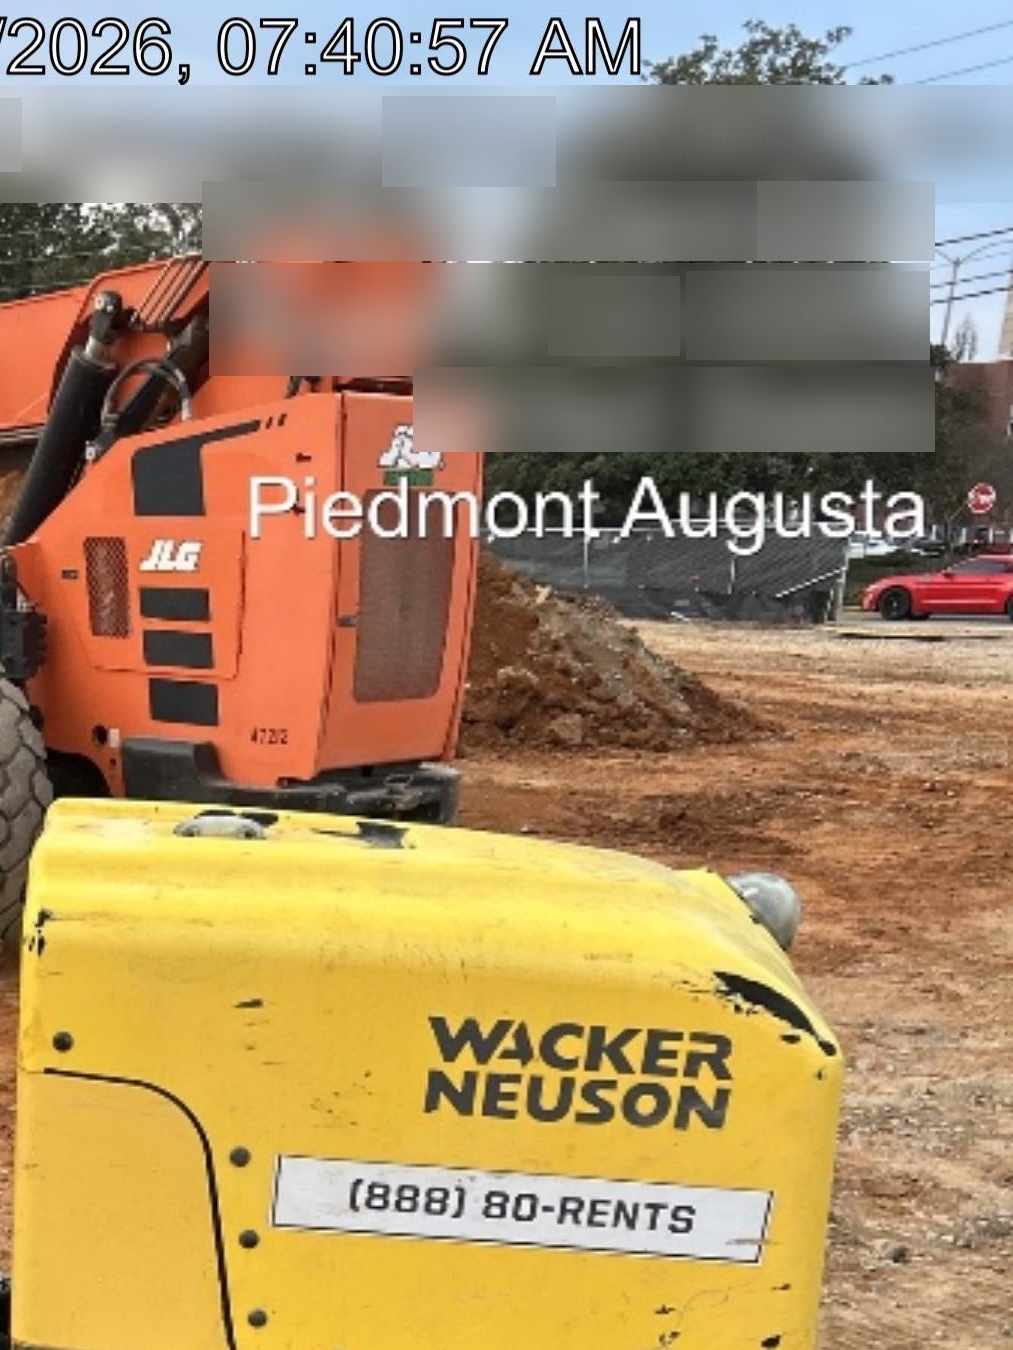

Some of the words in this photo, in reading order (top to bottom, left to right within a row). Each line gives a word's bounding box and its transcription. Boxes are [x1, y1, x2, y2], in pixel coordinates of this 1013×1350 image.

[139, 538, 202, 571] JLG
[428, 1015, 733, 1080] WACKER
[423, 1069, 732, 1131] NEUSON
[348, 1177, 465, 1217] (888)
[482, 1189, 696, 1234] 80-RENTS
